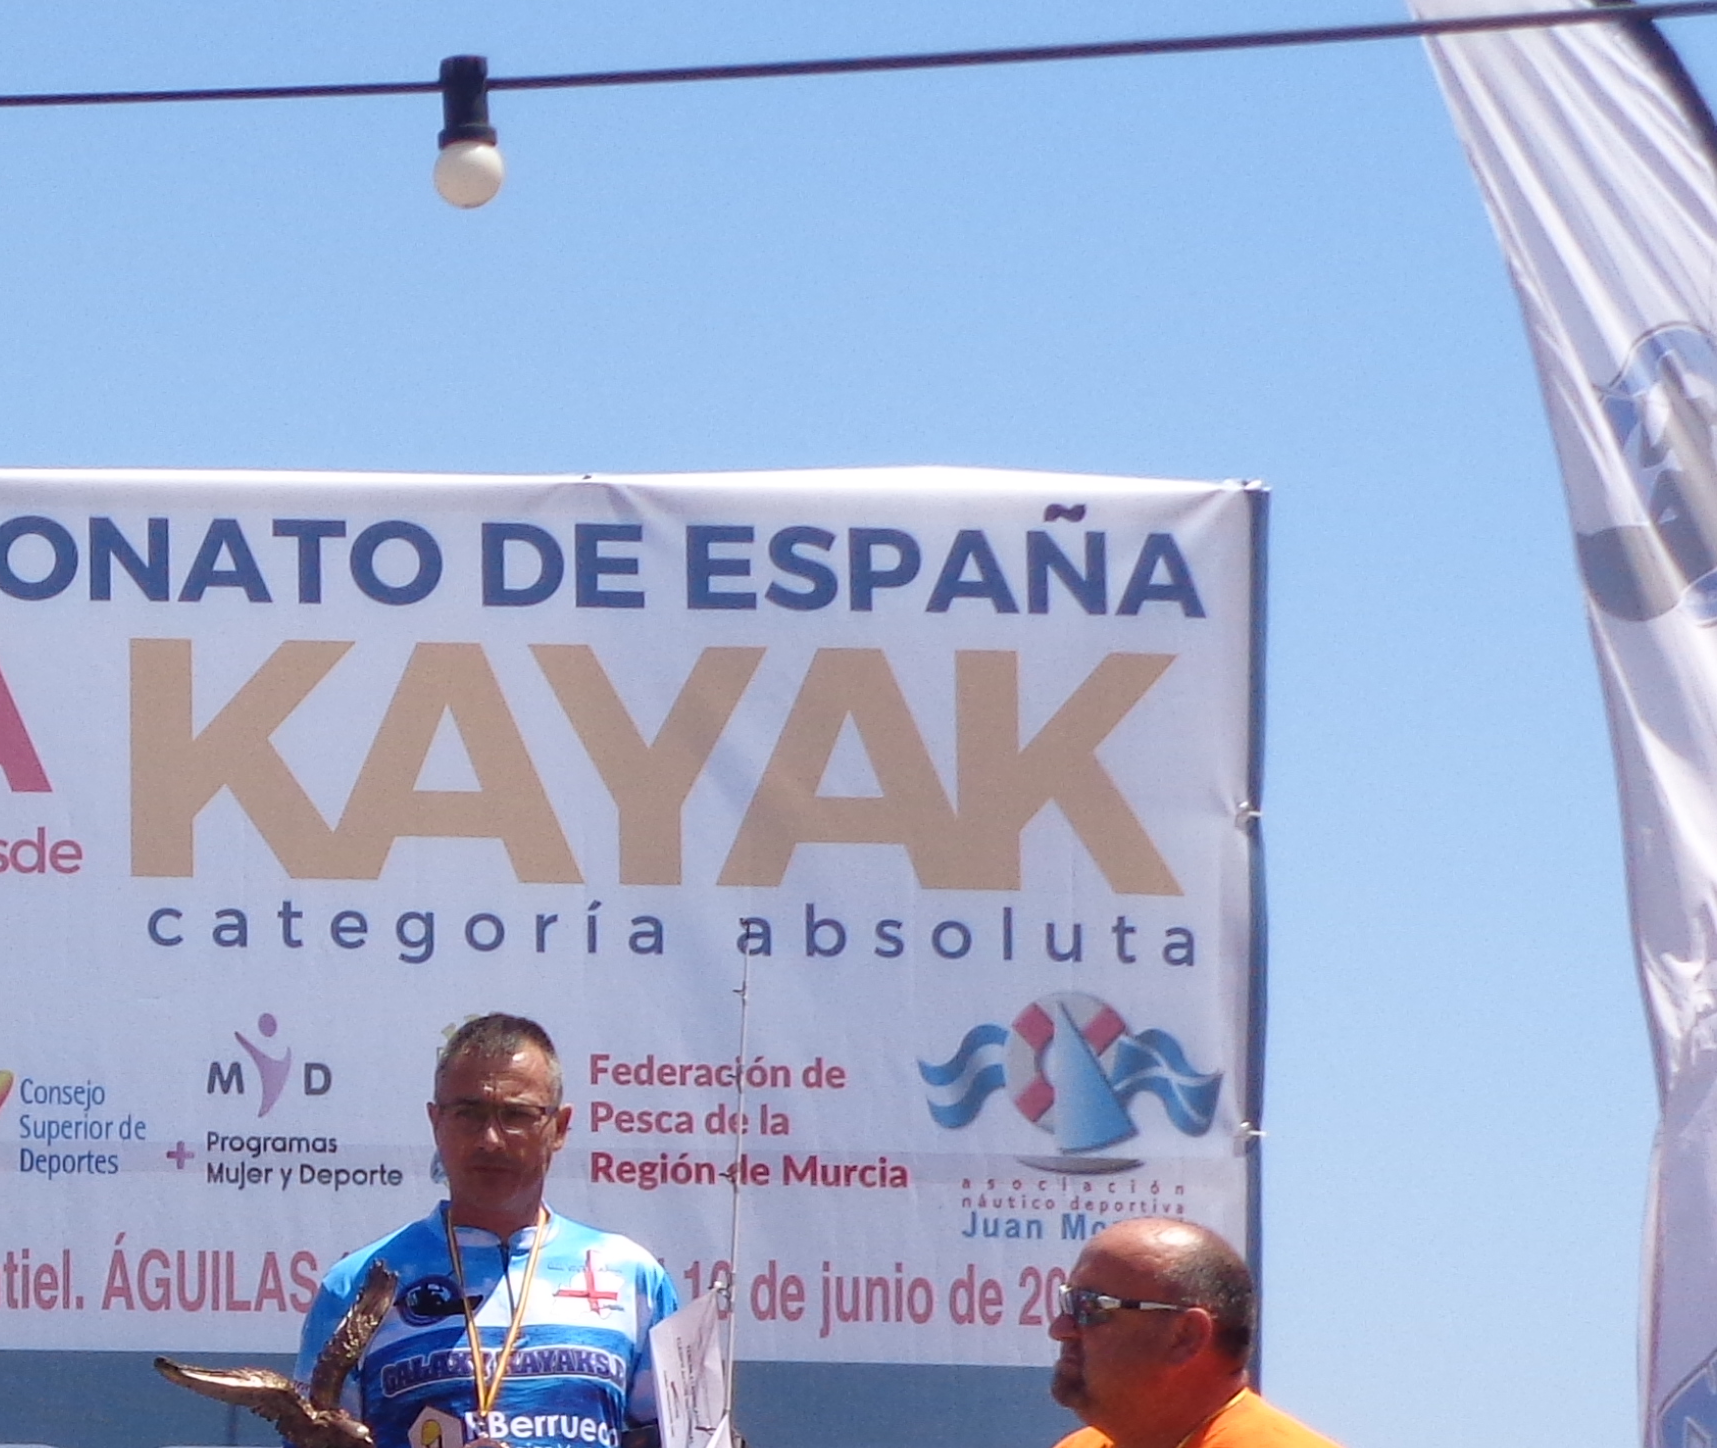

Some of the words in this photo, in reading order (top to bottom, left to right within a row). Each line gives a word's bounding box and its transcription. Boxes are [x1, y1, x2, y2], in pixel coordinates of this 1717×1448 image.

[482, 522, 645, 608] DE
[686, 503, 1206, 618] ESPAÑA
[129, 638, 1185, 896] KAYAK
[147, 897, 665, 963] categoría
[736, 904, 1197, 966] absoluta
[589, 1054, 792, 1090] Federación
[802, 1056, 847, 1089] de
[20, 1078, 106, 1108] Consejo
[20, 1115, 112, 1145] Superior
[119, 1115, 147, 1142] de
[590, 1102, 695, 1135] Pesca
[705, 1103, 749, 1136] de
[760, 1104, 790, 1136] la
[206, 1131, 338, 1157] Programas
[20, 1149, 119, 1177] Deportes
[206, 1163, 272, 1190] Mujer
[279, 1168, 294, 1190] y
[299, 1163, 404, 1190] Deporte
[590, 1152, 717, 1190] Región
[782, 1156, 909, 1189] Murcia
[962, 1175, 1185, 1196] asociación
[962, 1194, 1055, 1211] náutico
[1070, 1197, 1186, 1216] deportiva
[961, 1213, 1044, 1241] Juan
[101, 1232, 319, 1313] ÁGUILAS
[751, 1261, 807, 1322] de
[821, 1259, 934, 1339] junio
[949, 1262, 1004, 1325] de
